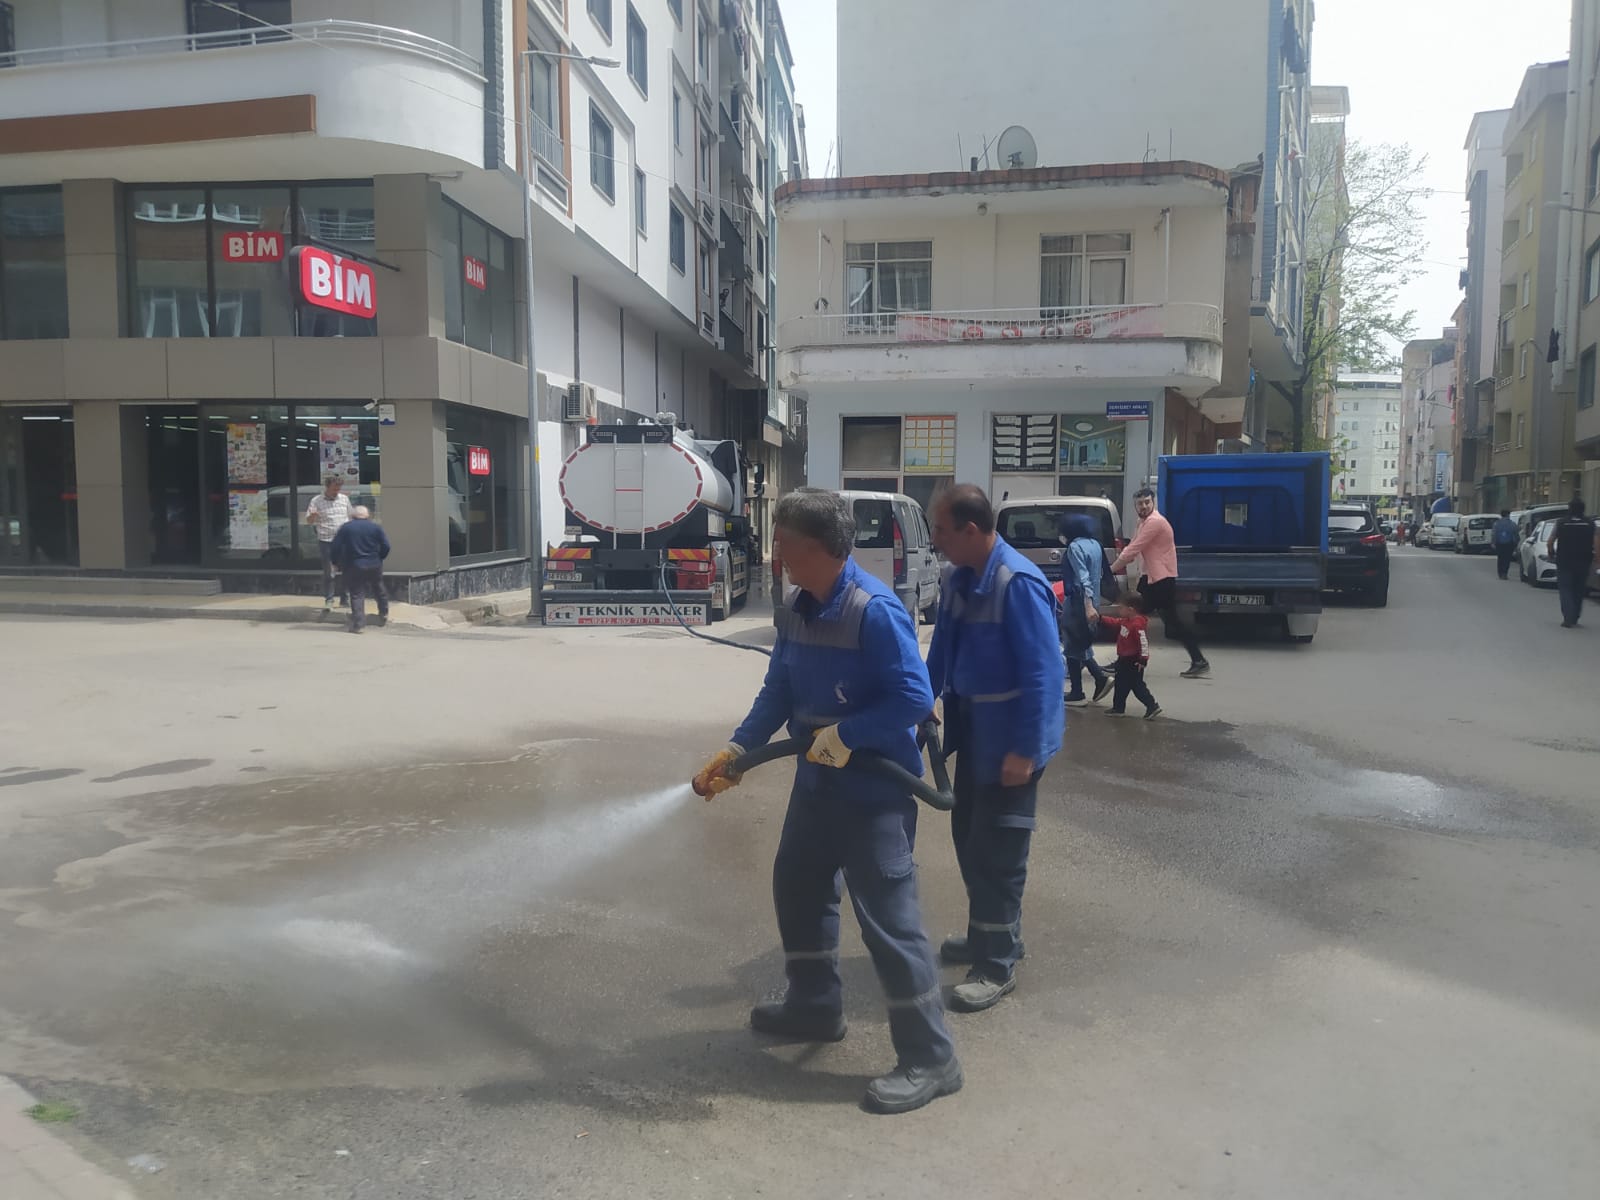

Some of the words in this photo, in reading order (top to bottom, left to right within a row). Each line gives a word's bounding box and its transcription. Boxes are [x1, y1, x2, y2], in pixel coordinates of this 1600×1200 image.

[228, 232, 278, 258] BİM
[310, 254, 372, 309] BİM
[466, 257, 484, 286] BİM
[471, 447, 488, 470] BİM
[577, 605, 634, 616] TEKNİK
[640, 606, 702, 616] TANKER
